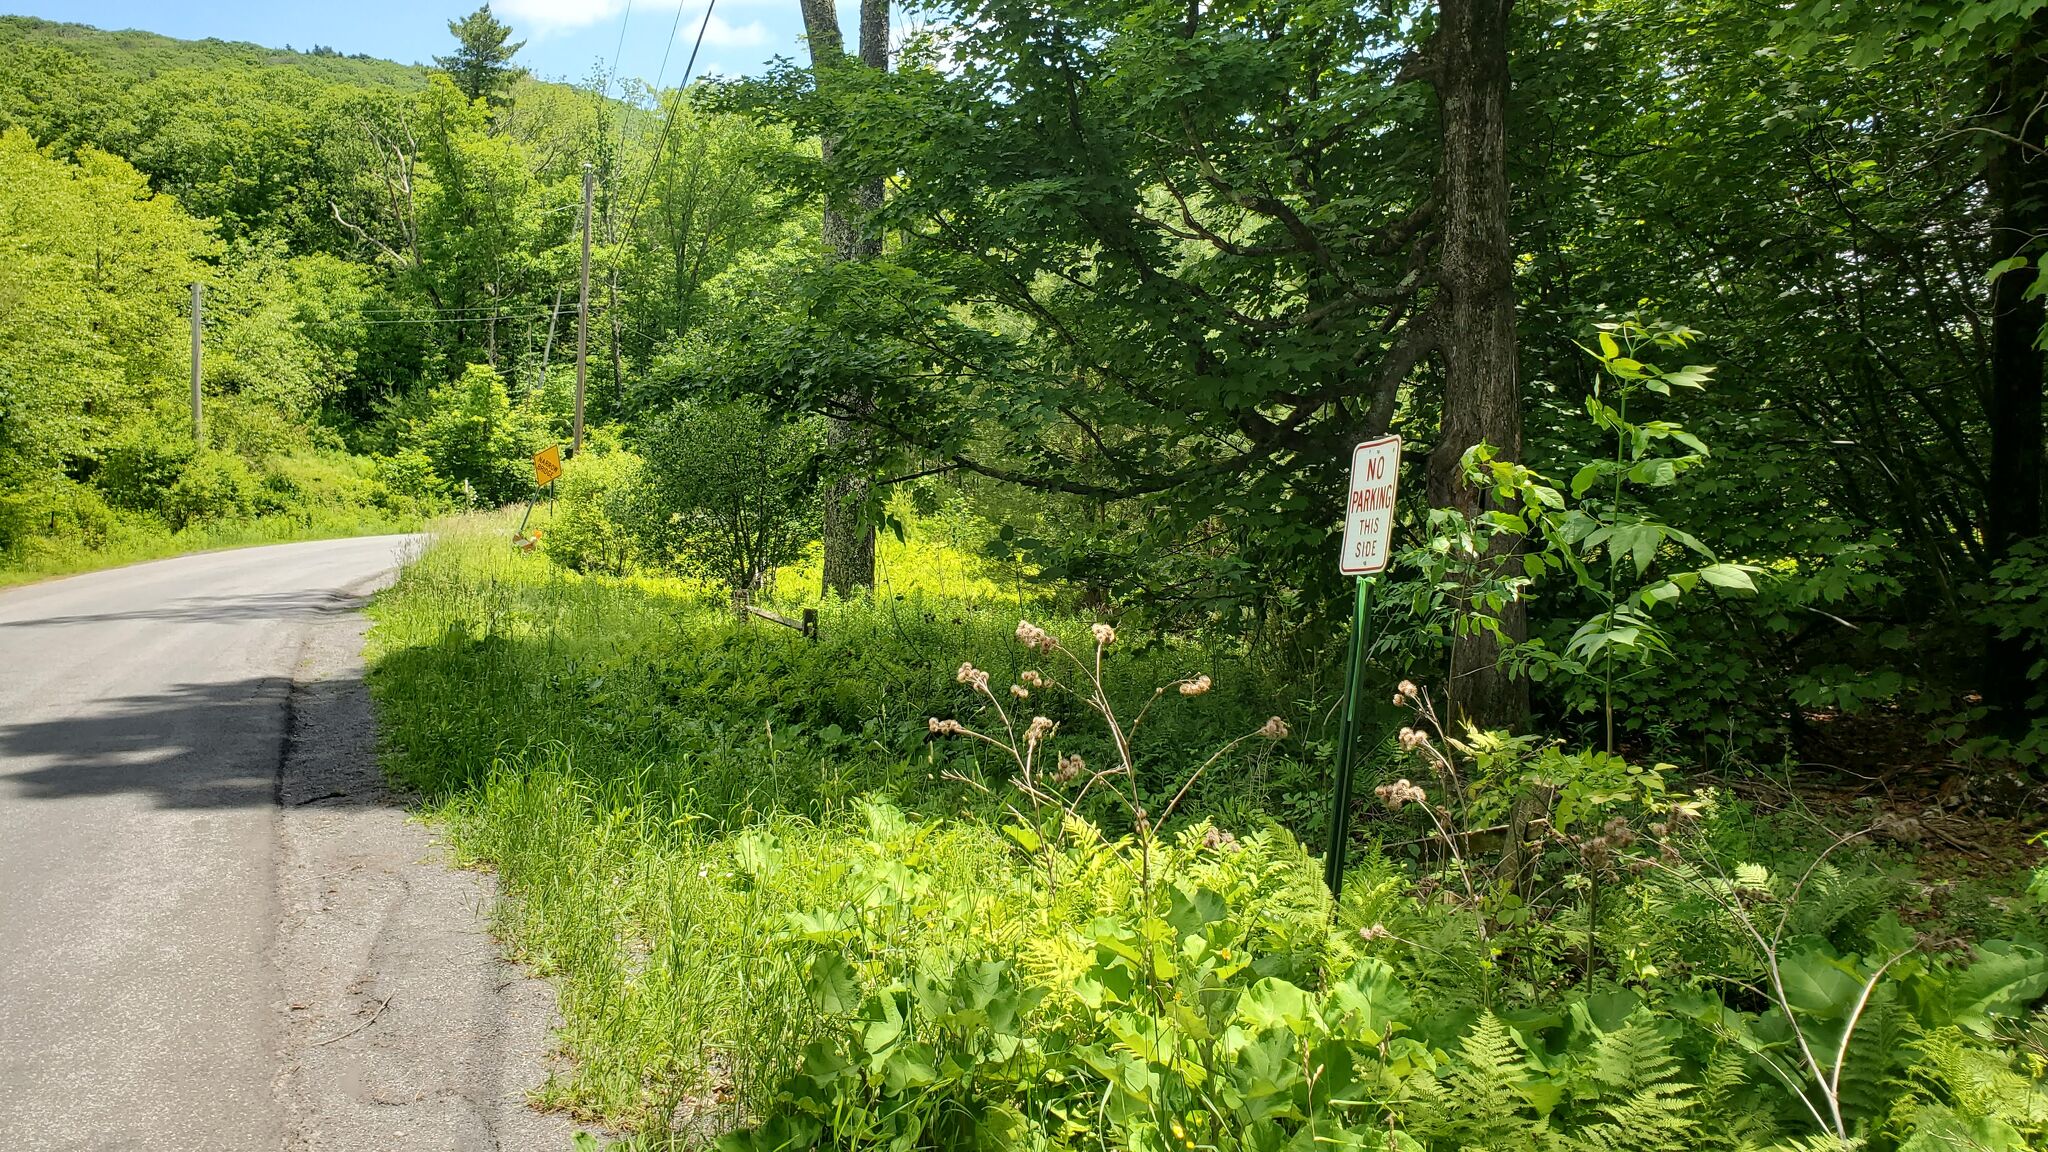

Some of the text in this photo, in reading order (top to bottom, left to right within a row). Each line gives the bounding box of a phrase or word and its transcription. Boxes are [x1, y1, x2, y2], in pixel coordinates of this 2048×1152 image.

[1367, 456, 1385, 481] NO
[1351, 484, 1392, 513] PARKING
[1360, 517, 1379, 535] THIS
[1355, 540, 1377, 558] SIDE
